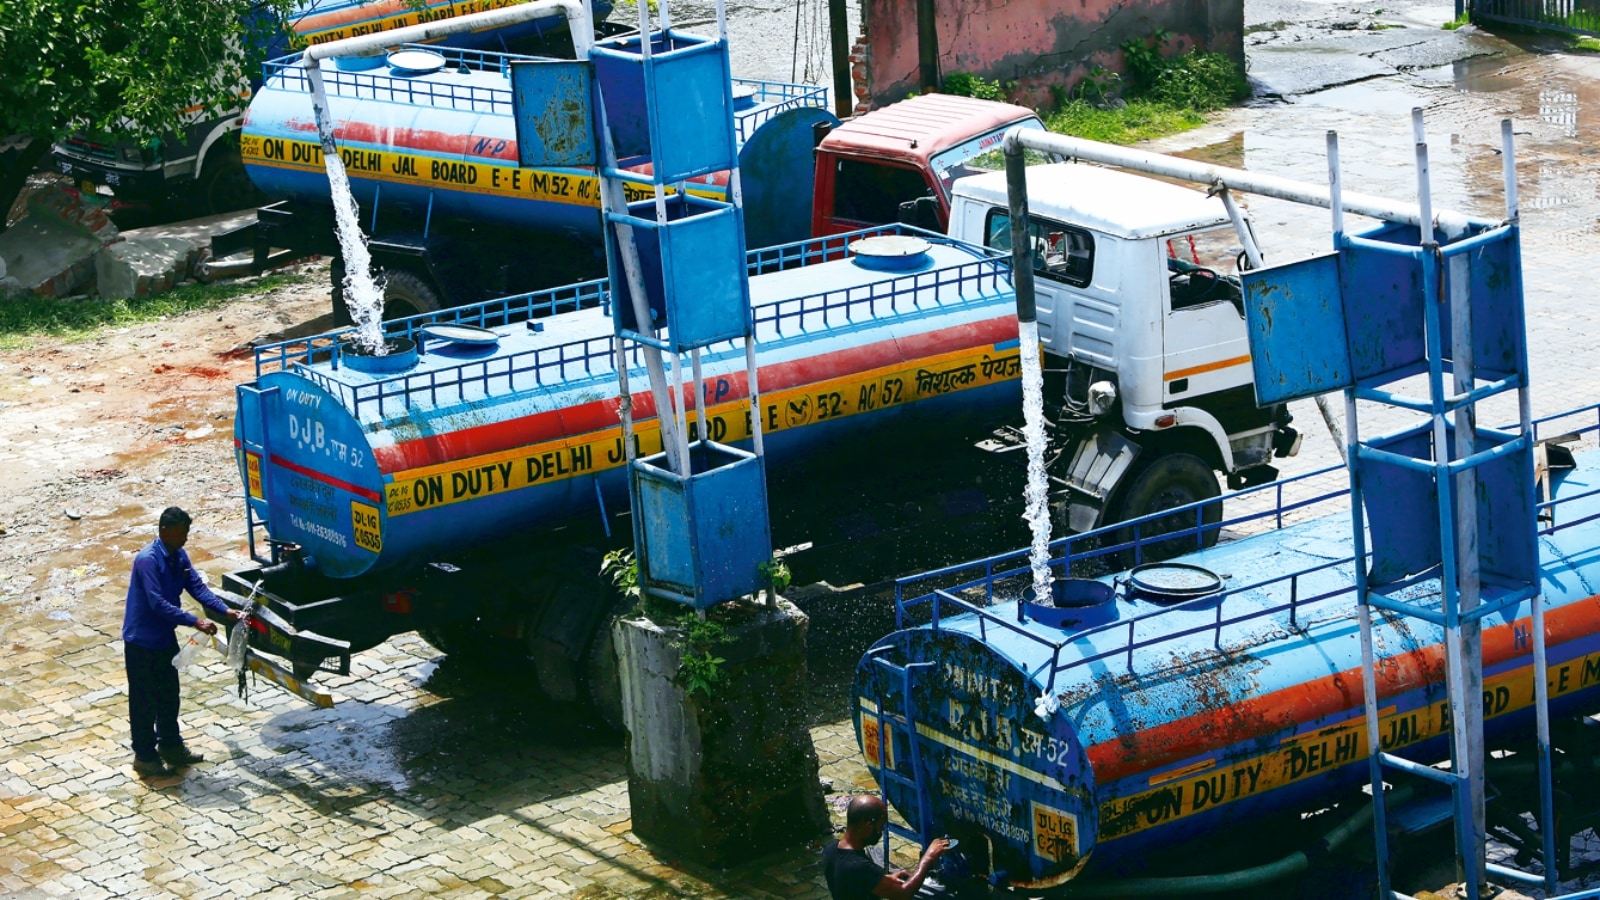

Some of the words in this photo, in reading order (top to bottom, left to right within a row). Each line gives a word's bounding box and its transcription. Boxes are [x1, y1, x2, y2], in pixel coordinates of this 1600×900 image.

[263, 138, 284, 160] ON
[292, 143, 323, 164] DUT
[343, 150, 381, 172] DELHI
[392, 155, 418, 177] JAL
[431, 162, 478, 185] BOARD
[577, 179, 591, 199] AC
[286, 388, 297, 403] ON
[298, 392, 322, 409] DUTY
[915, 363, 977, 395] निशुल्क
[980, 354, 1021, 380] पेयज
[350, 447, 364, 469] 52
[413, 475, 443, 507] ON
[452, 461, 513, 499] DUTY
[527, 444, 592, 483] DELHI
[858, 382, 876, 412] AC
[881, 377, 904, 405] 52
[1146, 785, 1184, 824] ON
[1192, 761, 1264, 811] DUTY
[1289, 732, 1359, 780] DELHI
[1381, 714, 1421, 749] JAL
